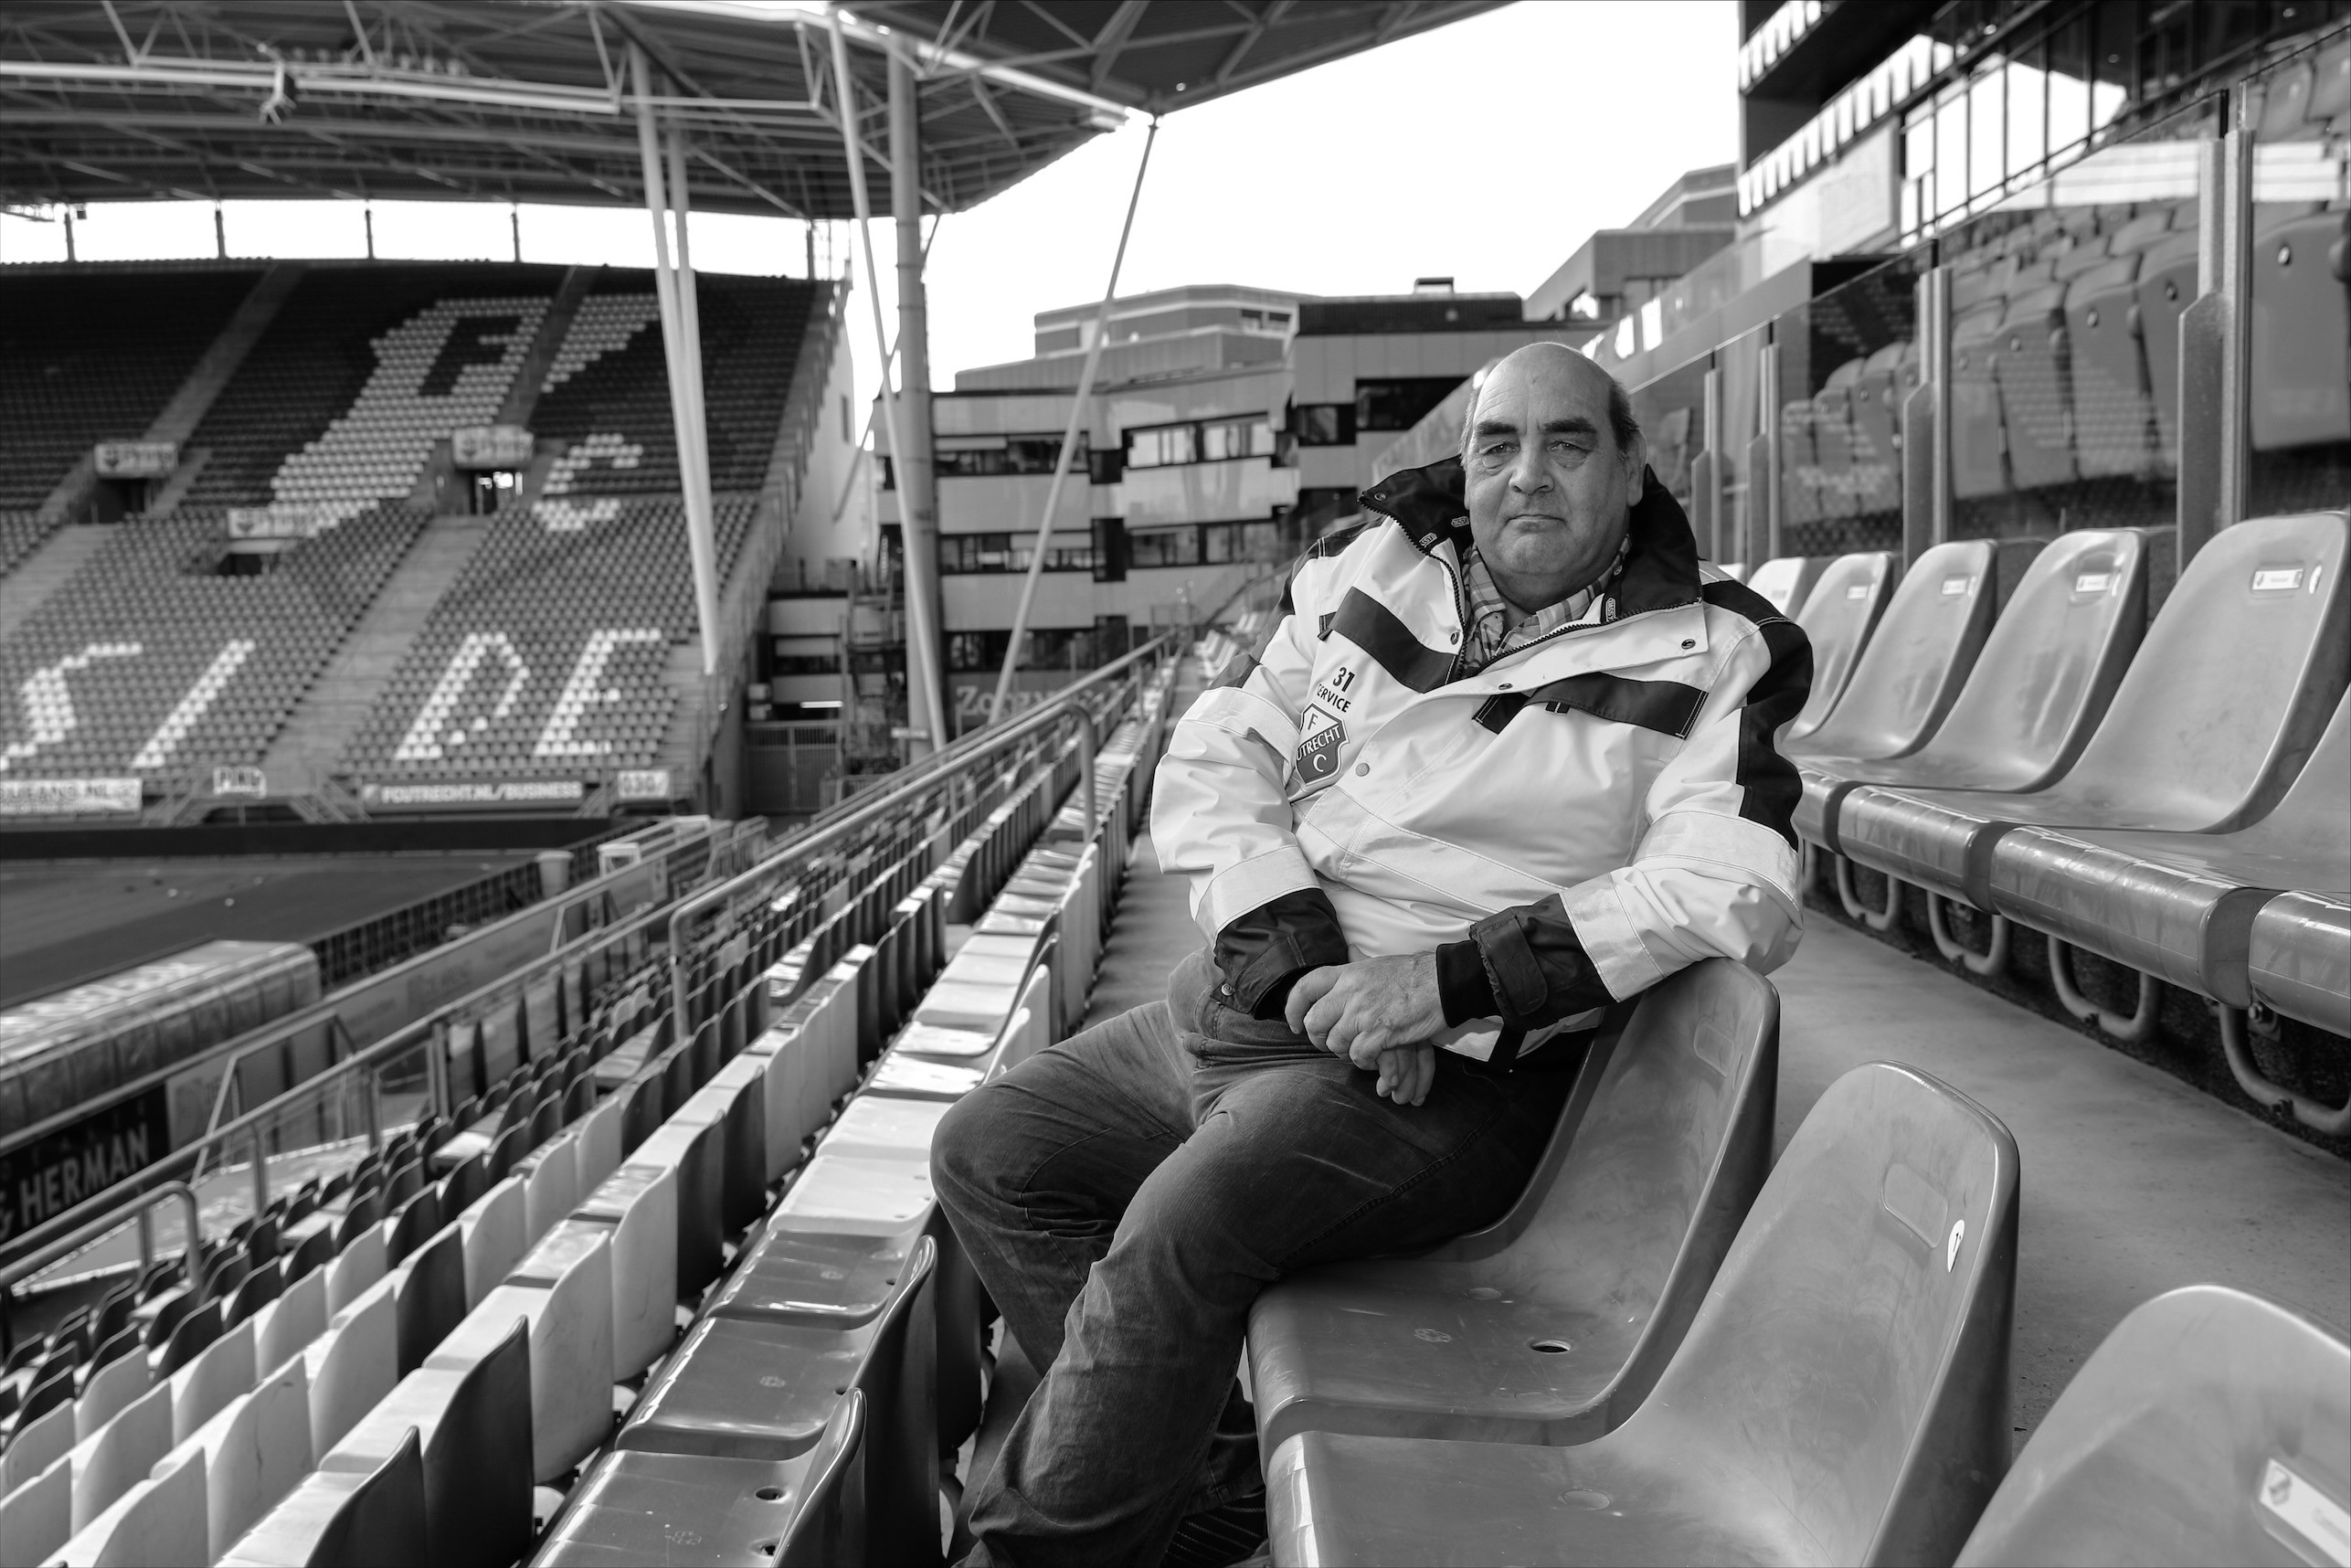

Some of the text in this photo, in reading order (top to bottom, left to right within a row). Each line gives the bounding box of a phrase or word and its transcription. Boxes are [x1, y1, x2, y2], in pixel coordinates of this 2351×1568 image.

[1332, 666, 1356, 693] 31
[1317, 683, 1351, 713] ERVICE
[1308, 713, 1318, 731] F
[1297, 726, 1341, 761] UTRECHT
[1312, 753, 1327, 773] C
[19, 1121, 150, 1228] HERMAN
